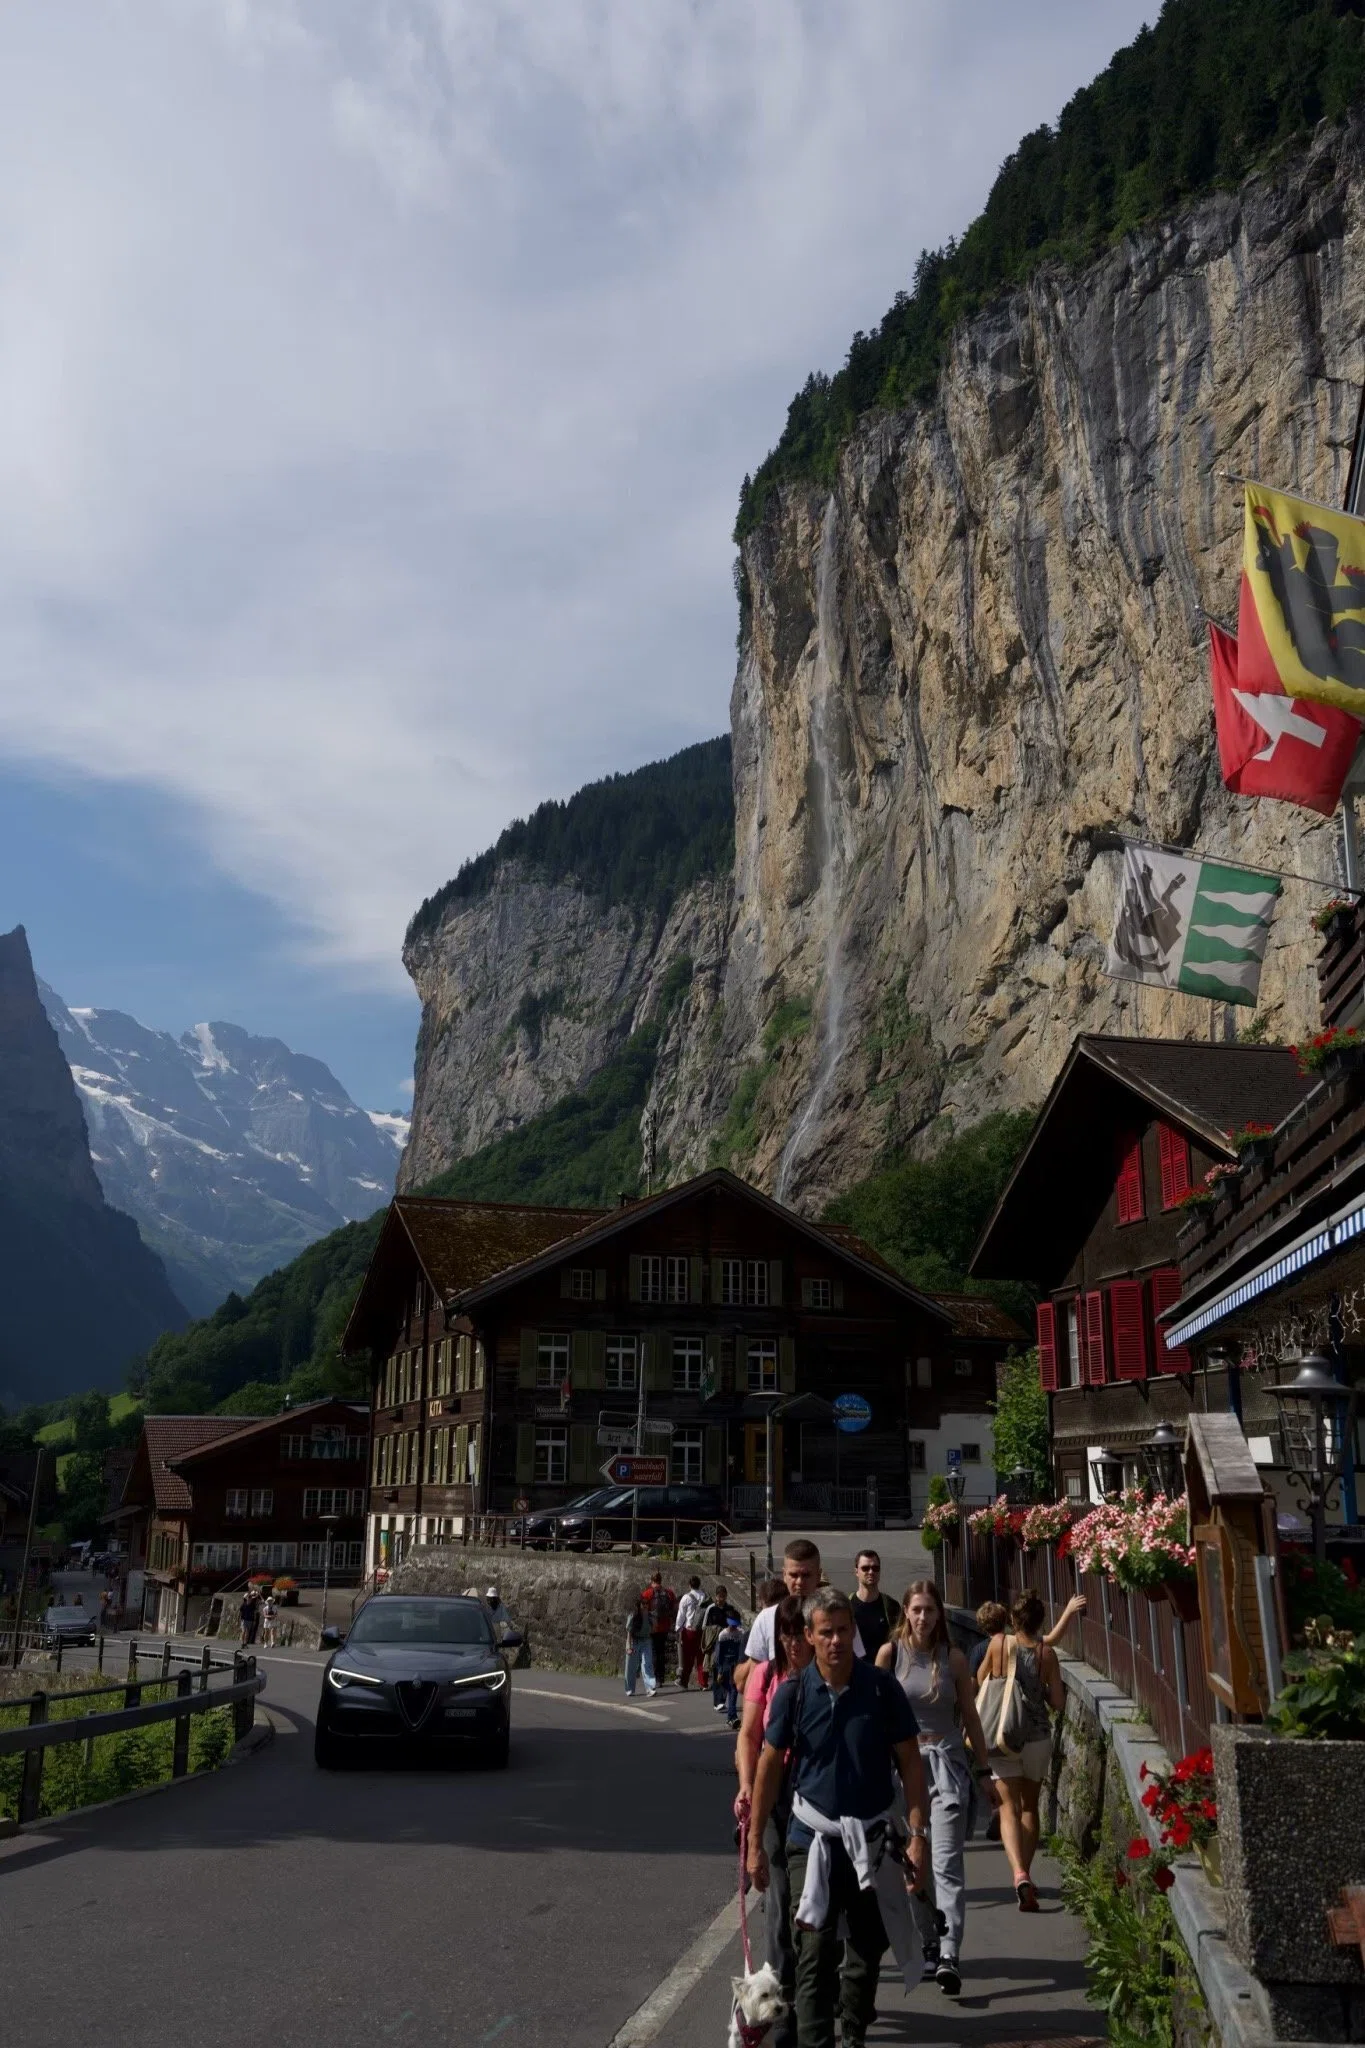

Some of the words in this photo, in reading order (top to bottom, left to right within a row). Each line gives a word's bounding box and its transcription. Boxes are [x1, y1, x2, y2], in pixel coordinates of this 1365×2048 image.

[608, 1434, 621, 1443] Arzt
[632, 1461, 665, 1470] Staubbach
[620, 1465, 628, 1477] P
[634, 1472, 664, 1483] waterfall
